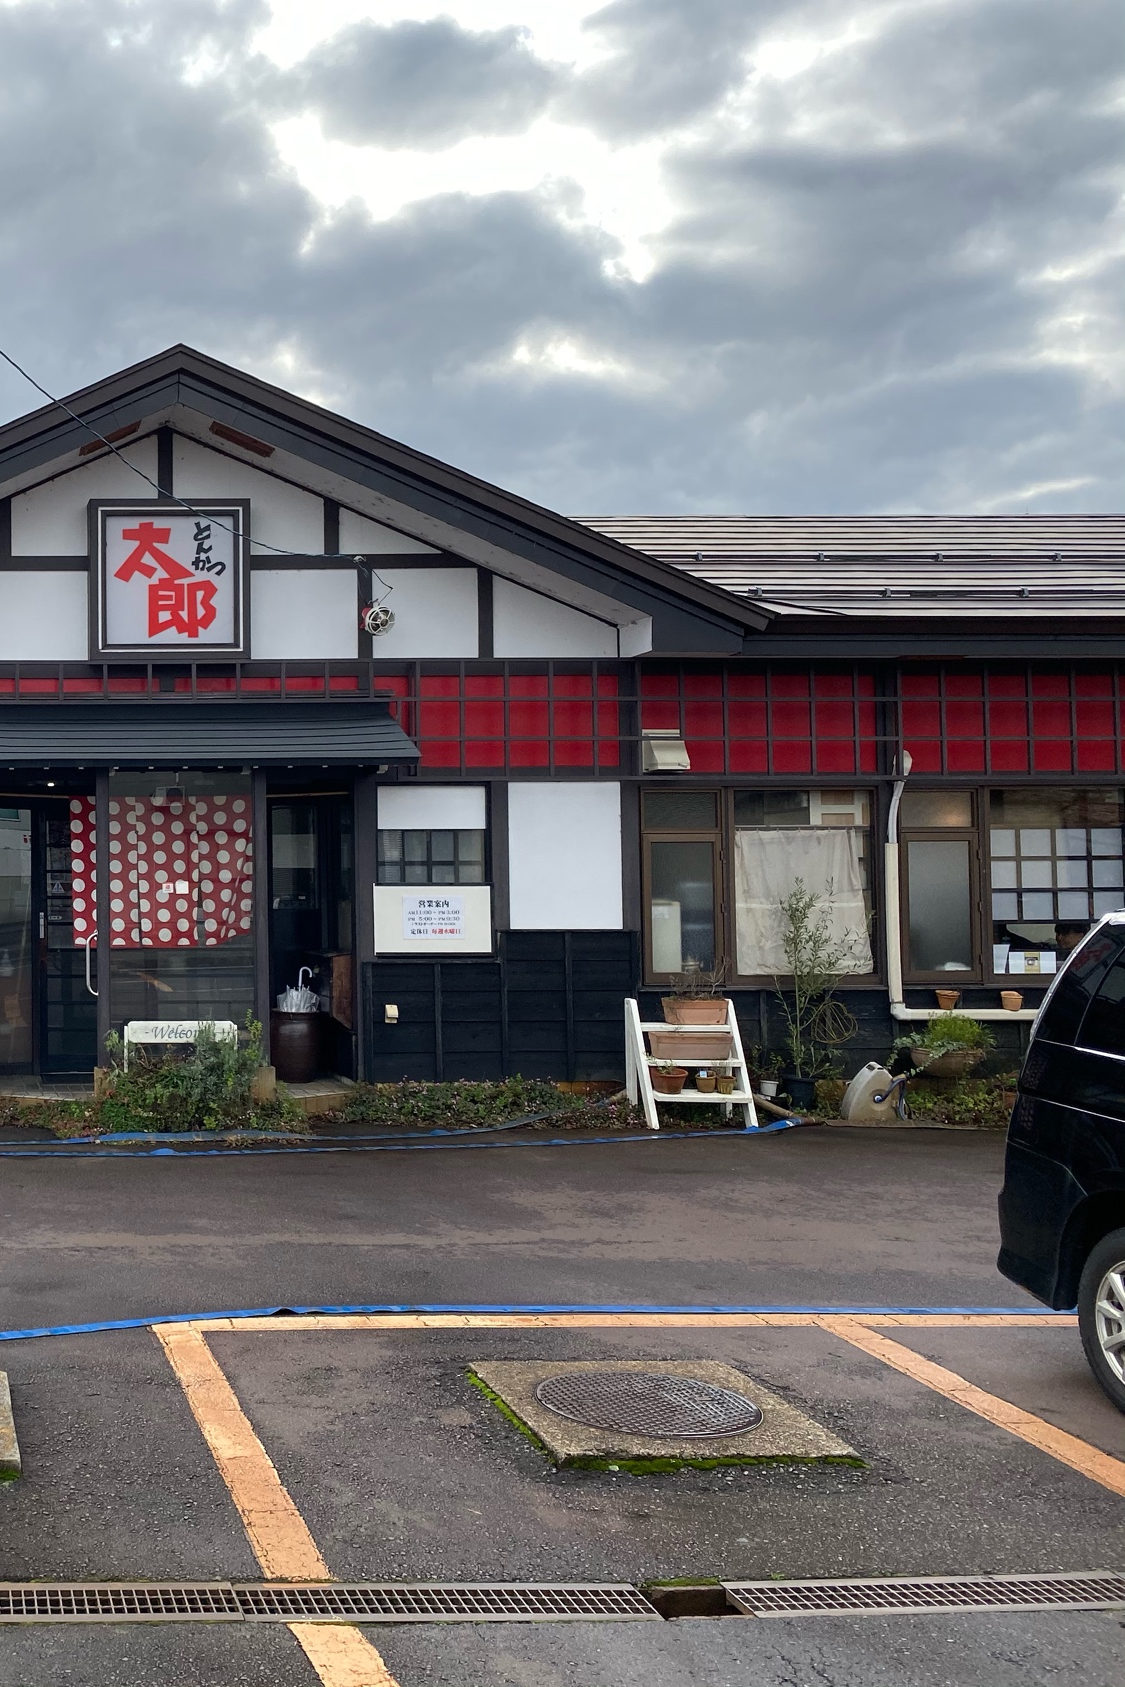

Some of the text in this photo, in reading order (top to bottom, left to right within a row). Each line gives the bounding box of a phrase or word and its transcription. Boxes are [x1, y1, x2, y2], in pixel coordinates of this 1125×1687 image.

[191, 521, 227, 576] とんかつ
[113, 521, 218, 638] 太郎
[418, 900, 449, 908] 営業案内
[152, 1024, 197, 1040] Welco
